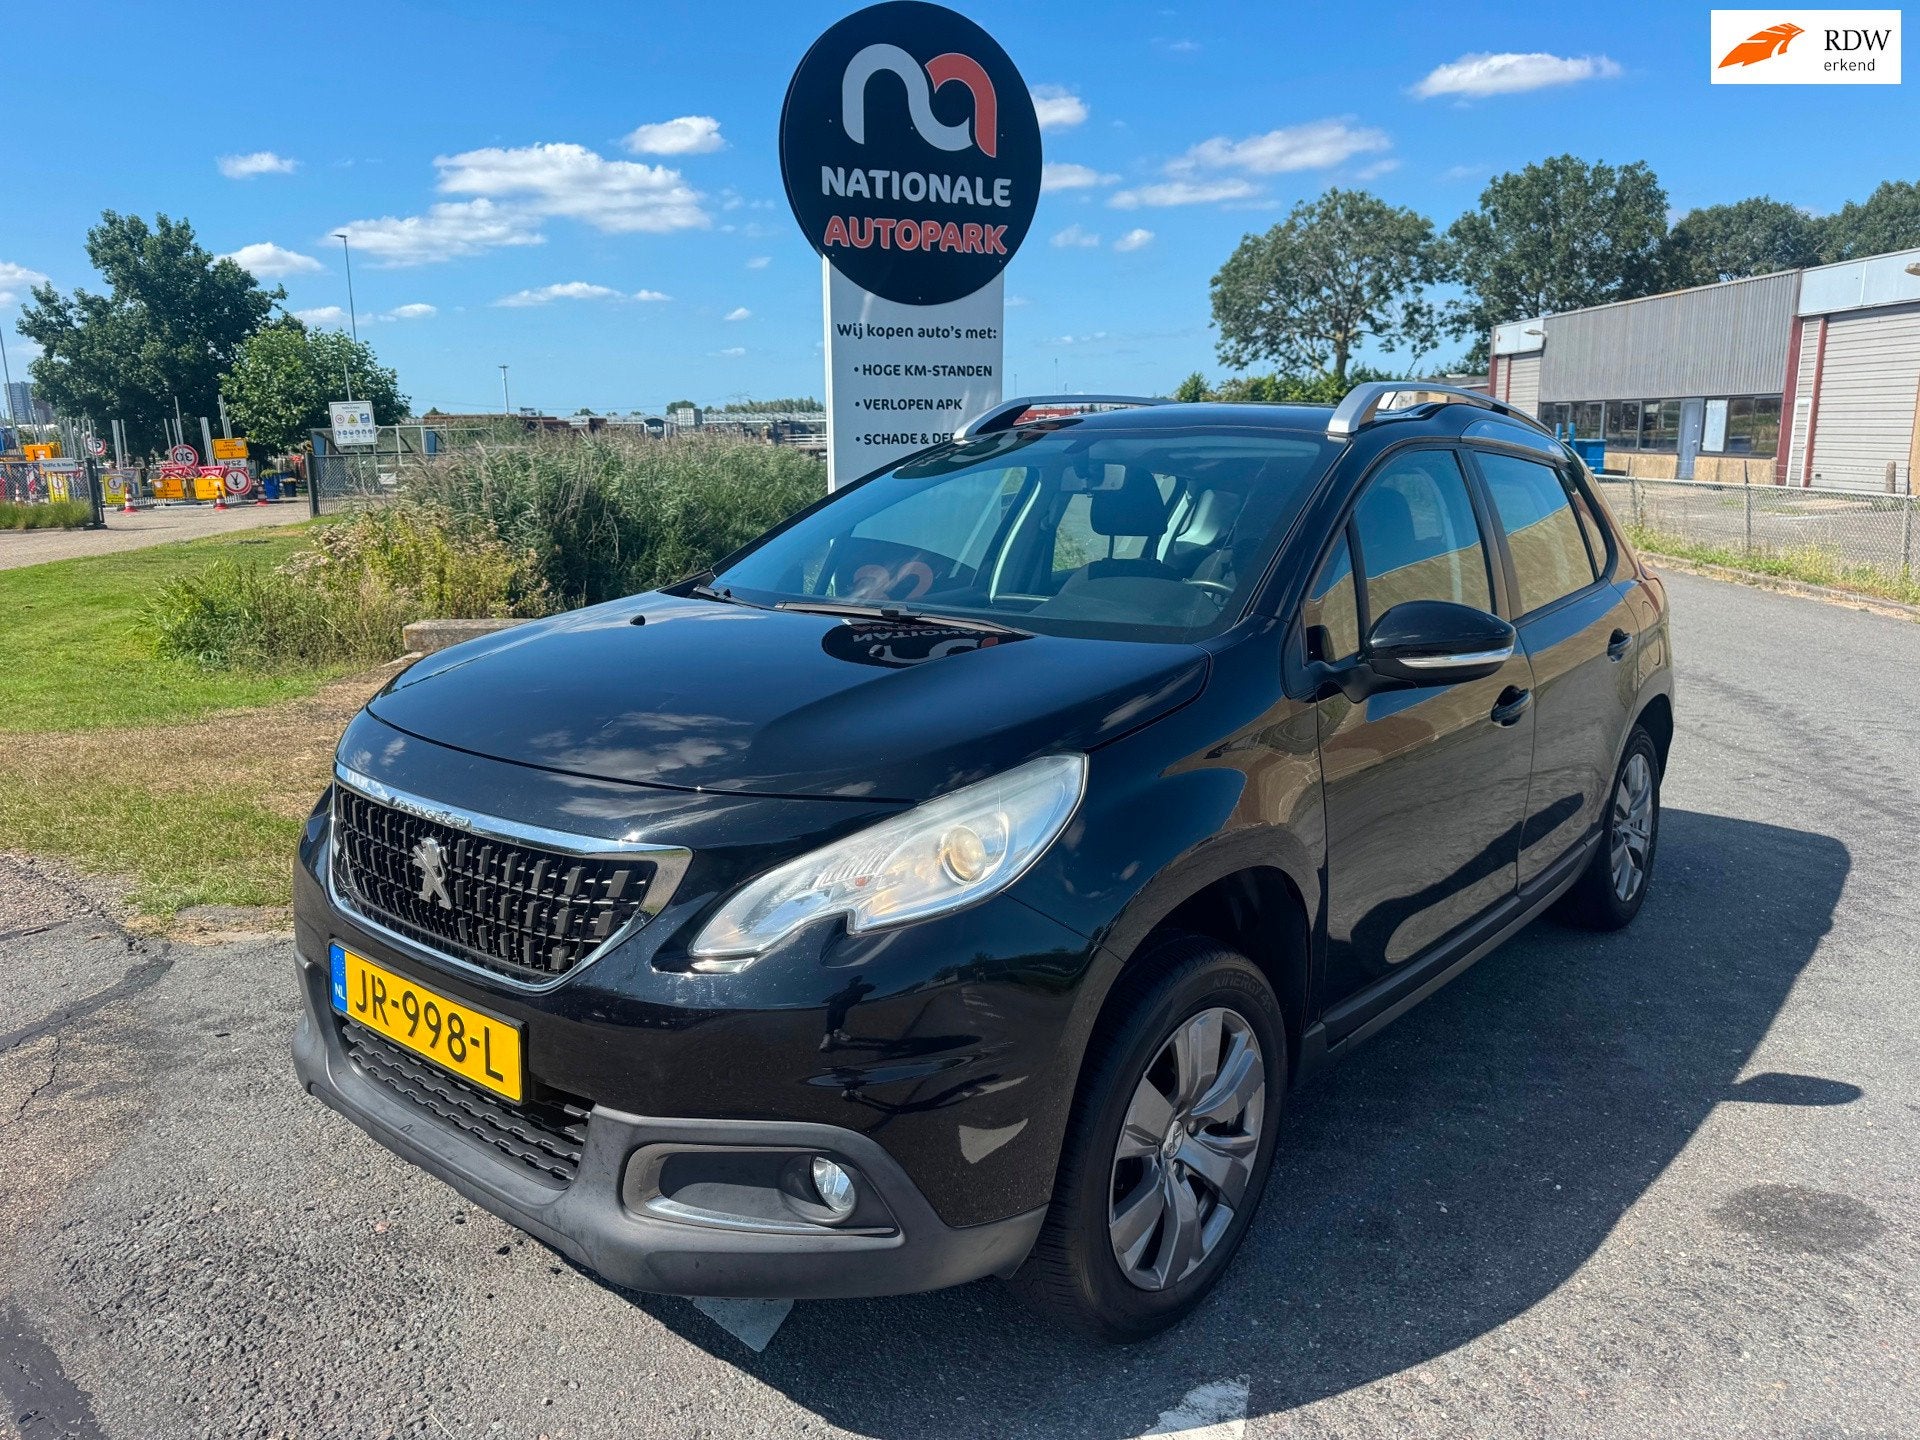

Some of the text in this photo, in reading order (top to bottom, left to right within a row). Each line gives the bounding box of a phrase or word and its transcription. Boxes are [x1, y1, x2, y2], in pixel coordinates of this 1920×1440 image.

[821, 165, 1012, 207] NATIONALE
[823, 215, 1008, 255] AUTOPARK
[837, 323, 997, 340] Wij kopen auto's met:
[862, 364, 992, 377] HOGE KM-STANDEN
[863, 398, 963, 410] VERLOPEN APK
[863, 433, 918, 445] SCHADE
[921, 434, 930, 444] &
[175, 451, 193, 462] 30
[334, 982, 346, 1000] NL
[355, 968, 504, 1083] JR-998-L
